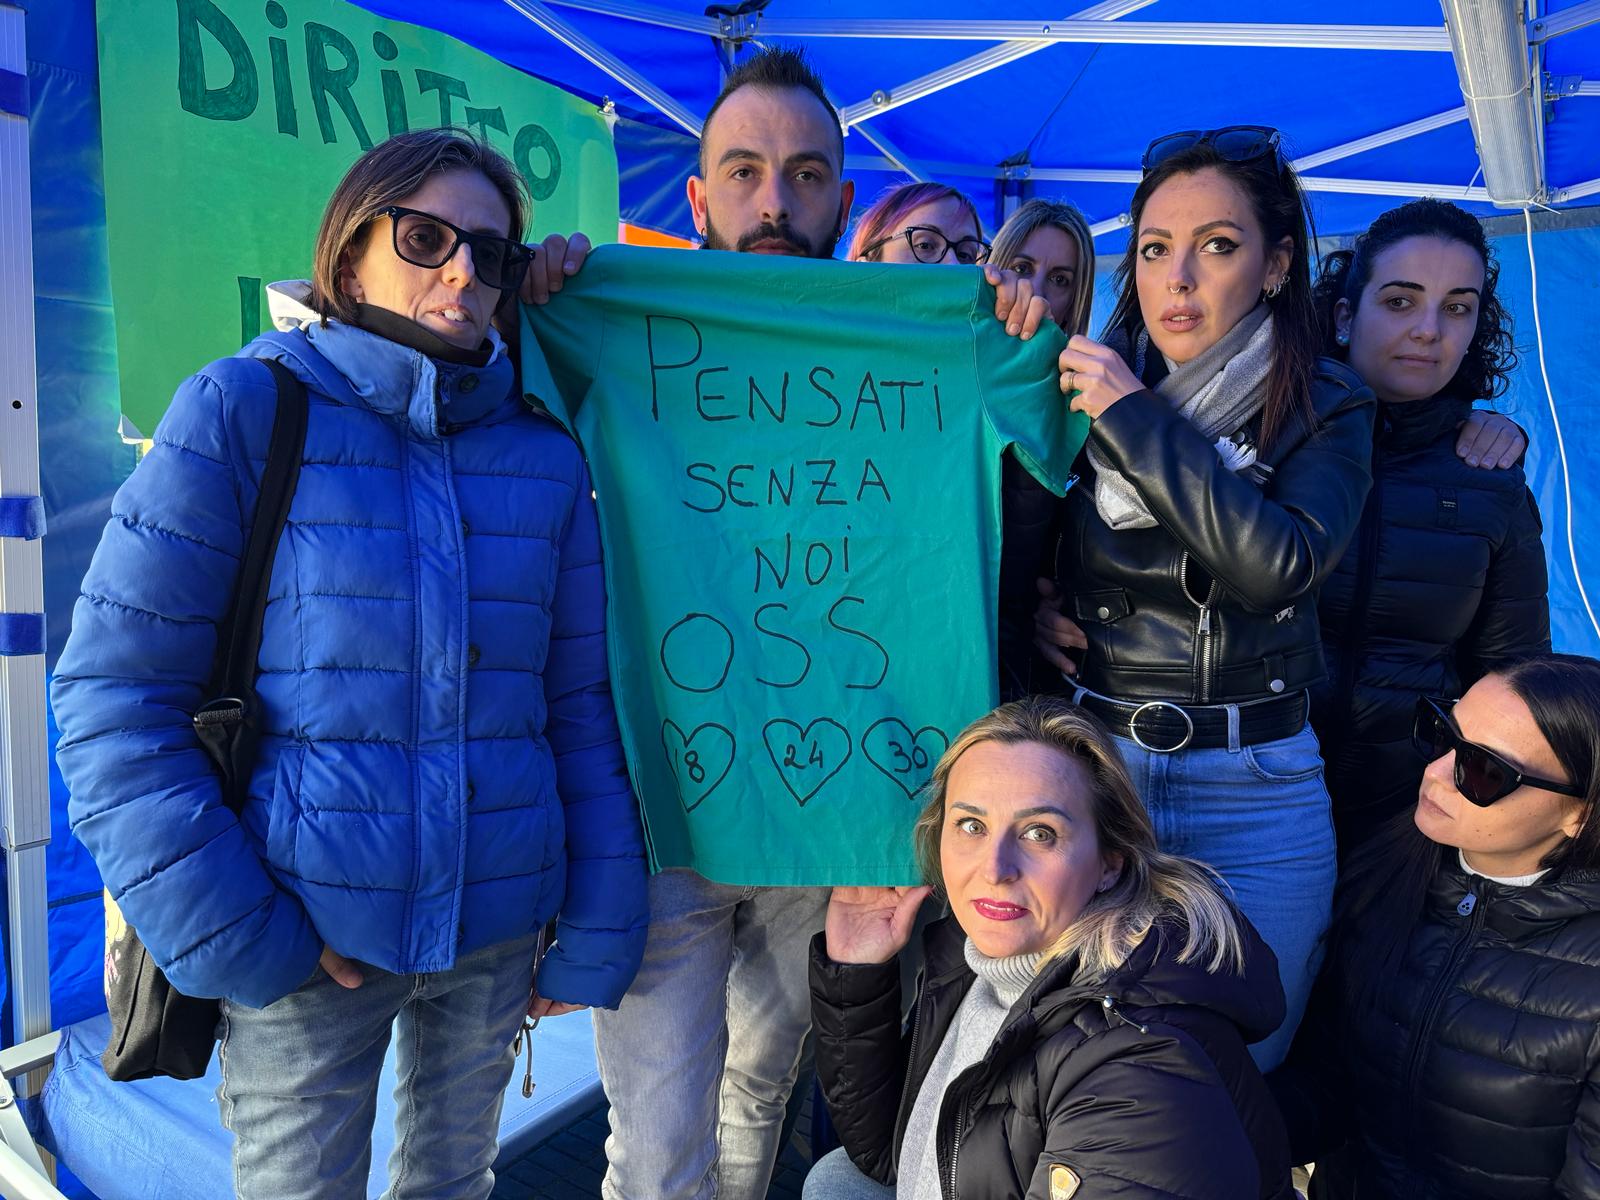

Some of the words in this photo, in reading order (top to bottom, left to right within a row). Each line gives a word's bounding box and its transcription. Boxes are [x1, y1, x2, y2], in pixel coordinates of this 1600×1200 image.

[682, 458, 892, 514] SENZA
[660, 596, 890, 693] OSS
[783, 740, 824, 770] 24
[887, 741, 929, 773] 30
